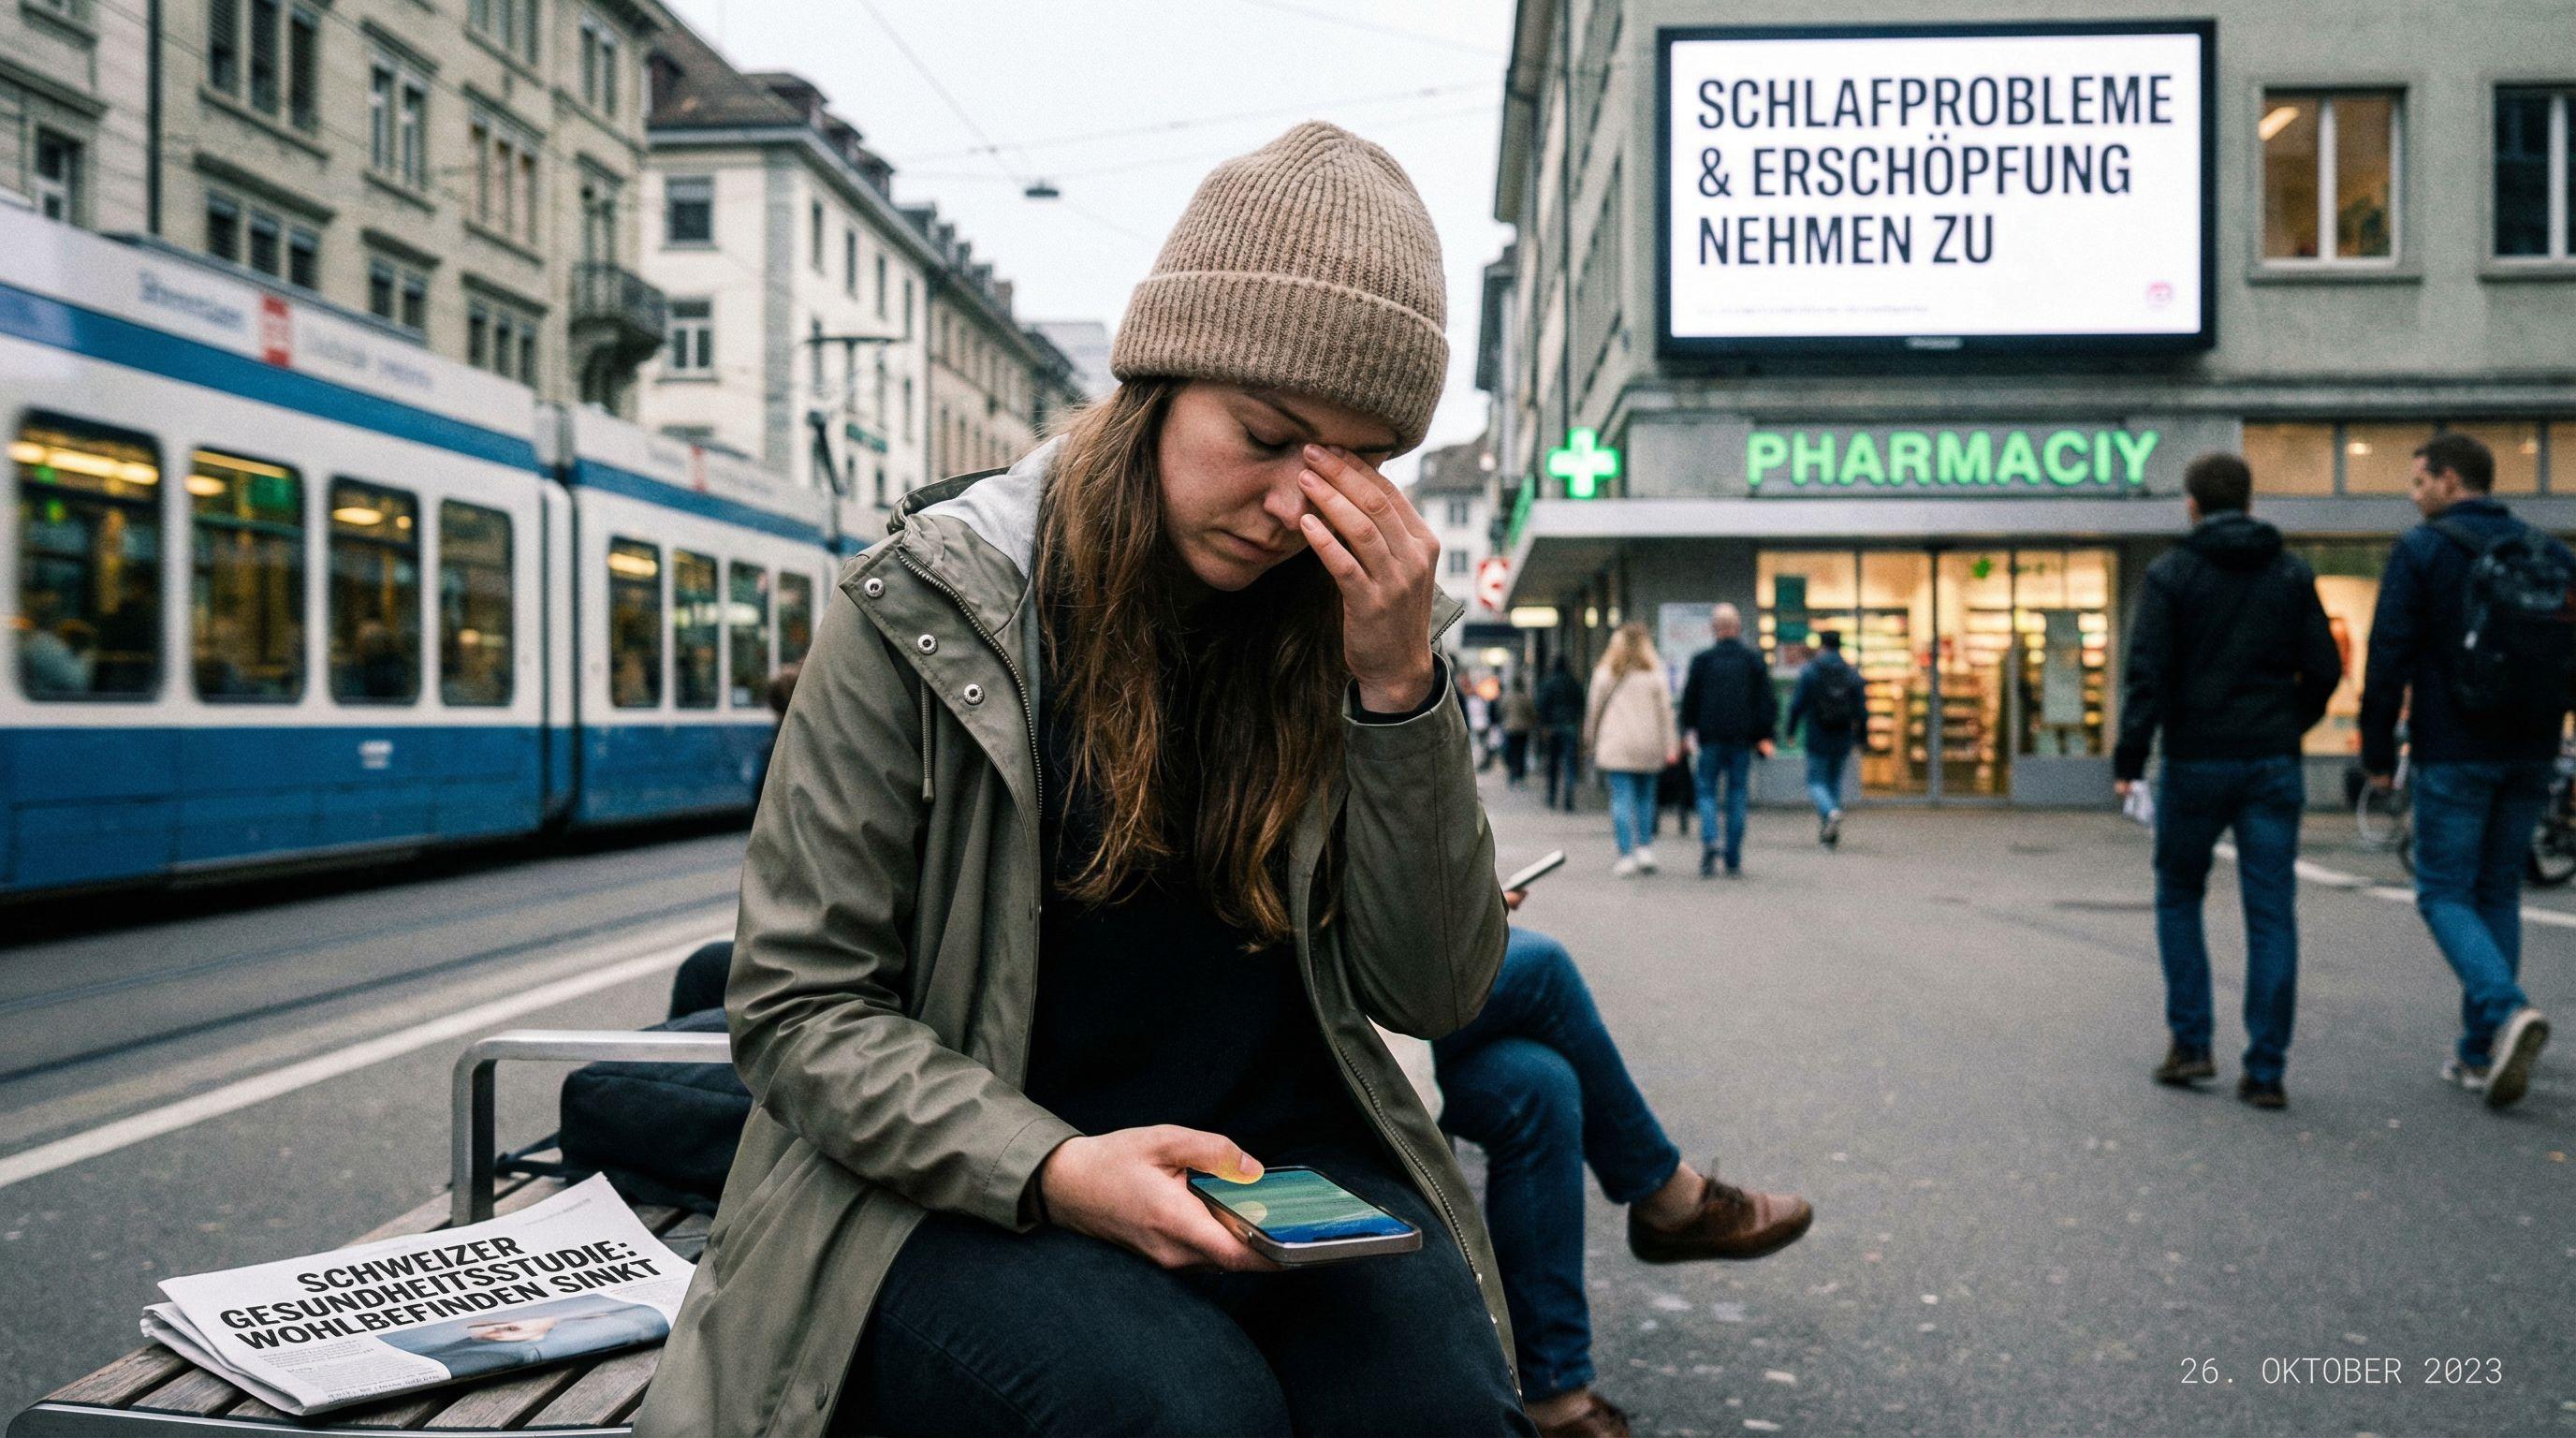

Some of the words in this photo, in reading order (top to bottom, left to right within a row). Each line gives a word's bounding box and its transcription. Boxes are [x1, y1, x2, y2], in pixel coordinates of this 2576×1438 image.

[1698, 74, 2173, 128] SCHLAFPROBLEME
[1698, 147, 1732, 198] &
[1753, 133, 2131, 197] ERSCHÖPFUNG
[1700, 215, 1911, 265] NEHMEN
[1932, 214, 1995, 264] ZU
[1746, 429, 2160, 488] PHARMACIY
[220, 1240, 637, 1329] GESUNDHEITSSTUDIE:
[297, 1237, 524, 1293] SCHWEIZER
[549, 1258, 662, 1293] SINKT
